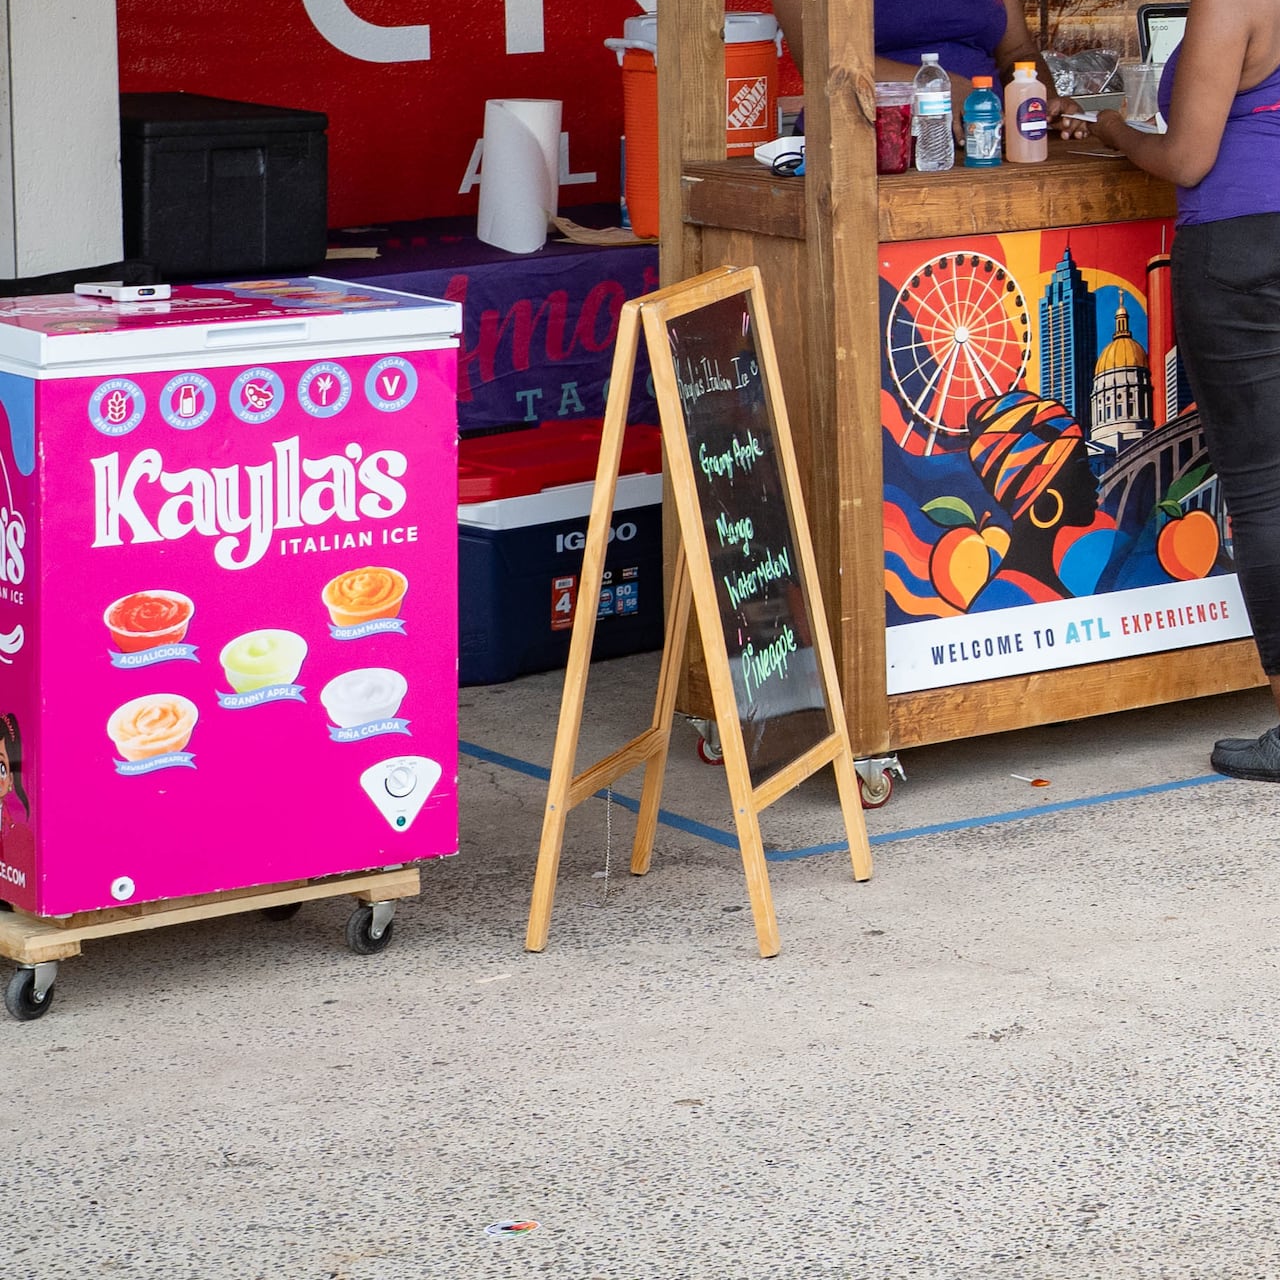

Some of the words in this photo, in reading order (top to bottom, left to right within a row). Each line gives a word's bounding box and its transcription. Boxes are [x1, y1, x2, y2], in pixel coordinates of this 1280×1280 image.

[727, 77, 767, 129] HOME
[732, 83, 751, 105] THE
[744, 96, 767, 128] DEPOT
[310, 363, 333, 376] REAL
[377, 358, 406, 370] VEGAN
[730, 356, 751, 390] Ice
[166, 376, 188, 393] DAIRY
[189, 375, 208, 389] FREE
[238, 371, 255, 385] SOY
[255, 369, 275, 381] FREE
[299, 371, 312, 395] WITH
[332, 365, 349, 385] CANE
[93, 380, 123, 402] GLUTEN
[122, 381, 141, 398] FREE
[381, 375, 401, 397] V
[302, 396, 319, 414] MADE
[732, 428, 764, 474] Apple
[91, 435, 408, 570] Kayla's
[280, 533, 373, 556] ITALIAN
[381, 526, 420, 545] ICE
[10, 590, 24, 605] ICE
[616, 584, 632, 597] 60
[555, 592, 572, 614] 4
[335, 626, 366, 638] DREAM
[366, 621, 400, 631] MANGO
[930, 629, 1025, 667] WELCOME
[1032, 627, 1056, 651] TO
[1064, 616, 1112, 646] ATL
[1120, 600, 1230, 637] EXPERIENCE
[119, 646, 188, 666] AQUALICIOUS
[223, 691, 266, 707] GRANNY
[266, 686, 299, 699] APPLE
[337, 727, 360, 740] PIÑA
[360, 721, 400, 736] COLADA
